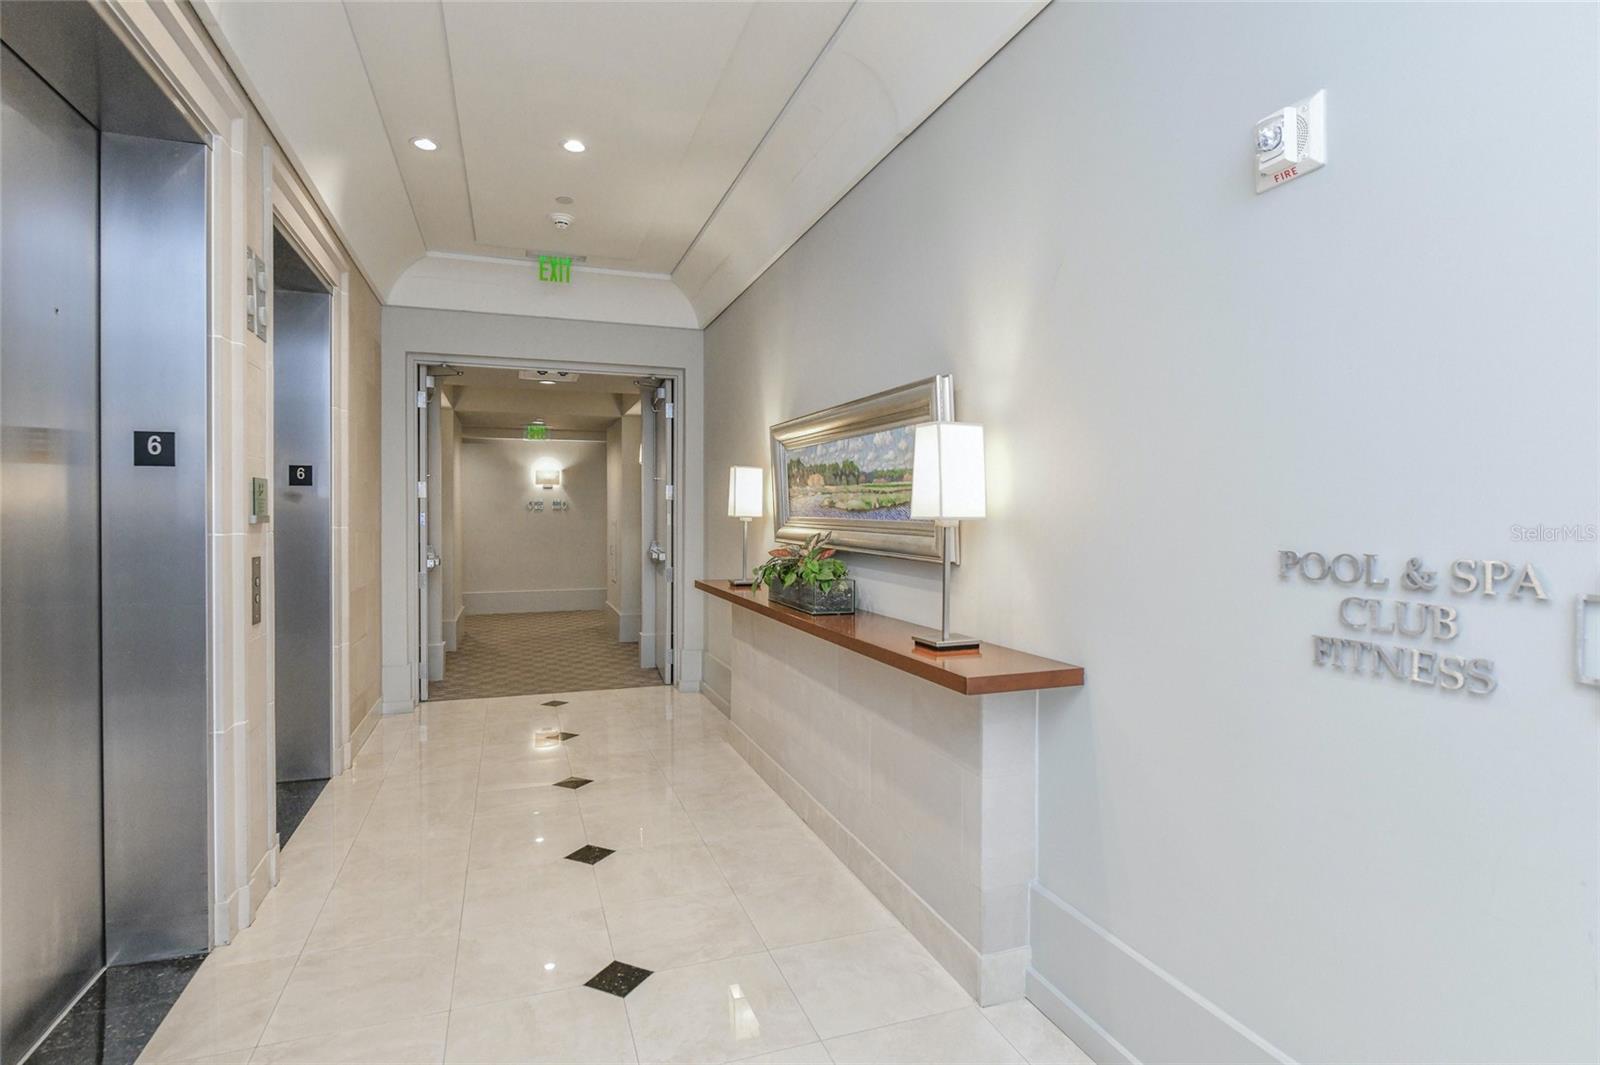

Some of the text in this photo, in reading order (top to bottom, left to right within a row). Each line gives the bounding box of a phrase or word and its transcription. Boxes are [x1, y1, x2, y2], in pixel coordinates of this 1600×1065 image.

[1273, 166, 1298, 183] FIRE
[538, 255, 572, 284] EXIT
[147, 435, 162, 456] 6
[296, 467, 306, 480] 6
[1278, 549, 1550, 600] POOL & SPA
[1339, 597, 1460, 641] CLUB
[1311, 634, 1498, 695] FITNESS
